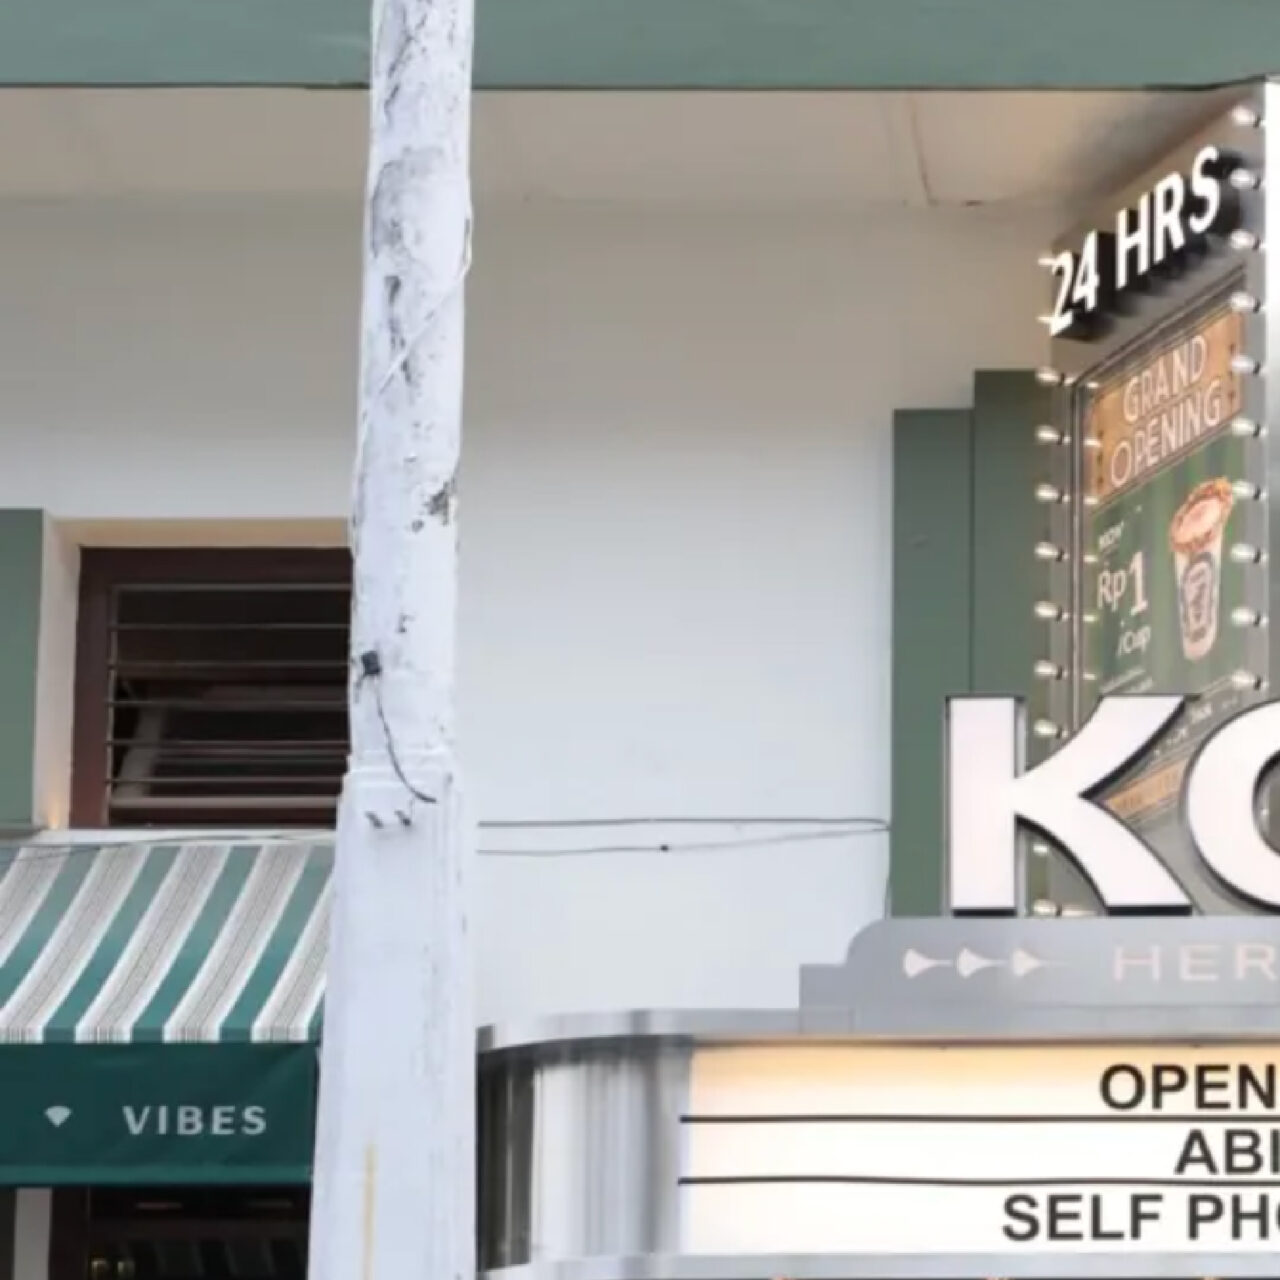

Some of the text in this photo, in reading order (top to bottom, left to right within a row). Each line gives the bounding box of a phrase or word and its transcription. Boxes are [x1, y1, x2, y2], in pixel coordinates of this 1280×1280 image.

[1049, 146, 1220, 335] 24 HRS
[1122, 335, 1207, 424] GRAND
[1109, 378, 1222, 487] OPENING
[122, 1105, 268, 1136] VIBES
[1001, 1194, 1164, 1242] SELF
